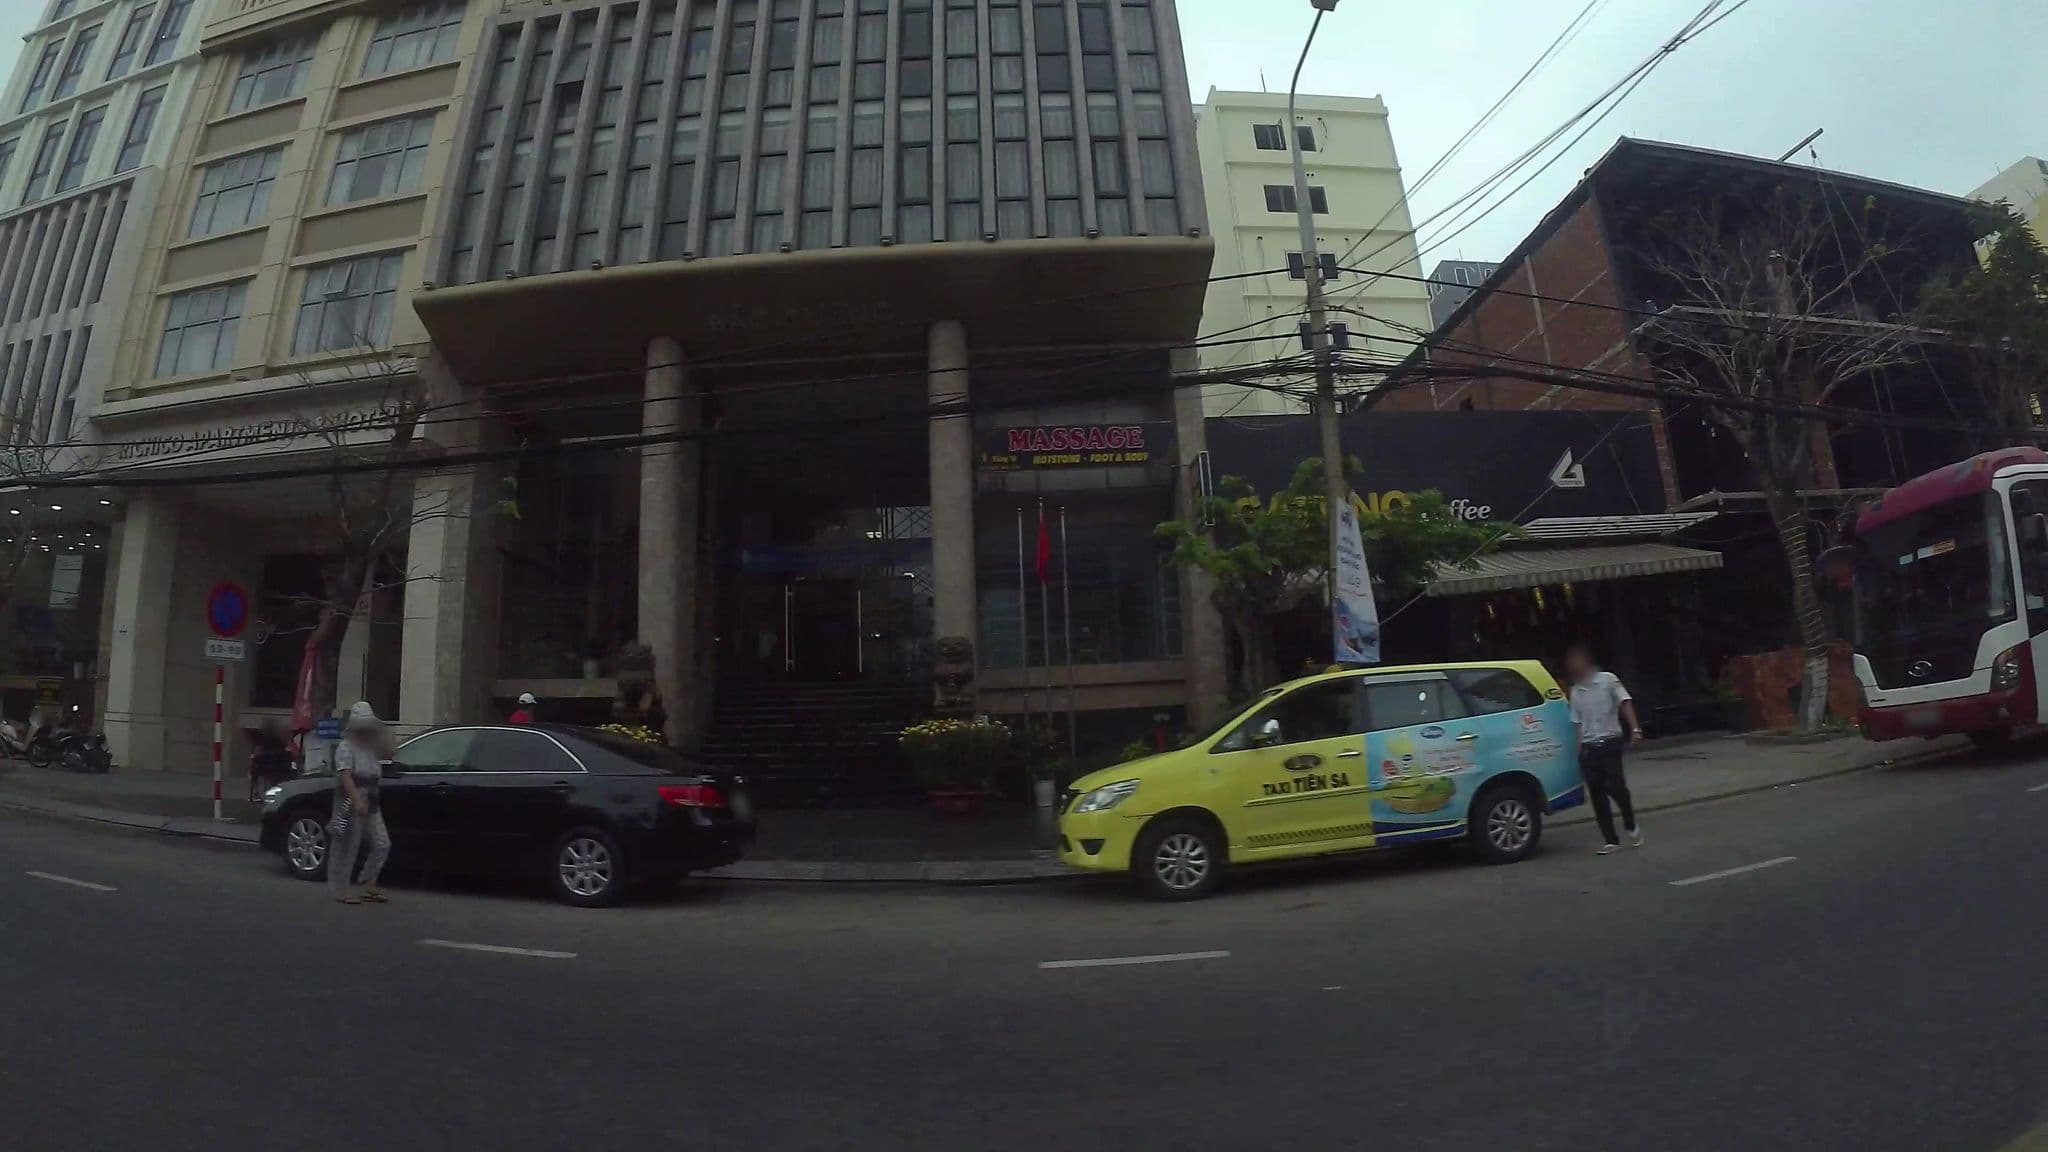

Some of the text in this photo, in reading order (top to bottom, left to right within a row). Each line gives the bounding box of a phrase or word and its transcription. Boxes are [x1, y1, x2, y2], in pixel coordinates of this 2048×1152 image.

[1008, 425, 1145, 452] MASSAGE
[1032, 453, 1082, 465] HOTSTONE
[1089, 453, 1114, 463] FOOT
[1124, 451, 1149, 462] BODY
[1263, 781, 1291, 796] TAXI
[1331, 772, 1350, 789] SA
